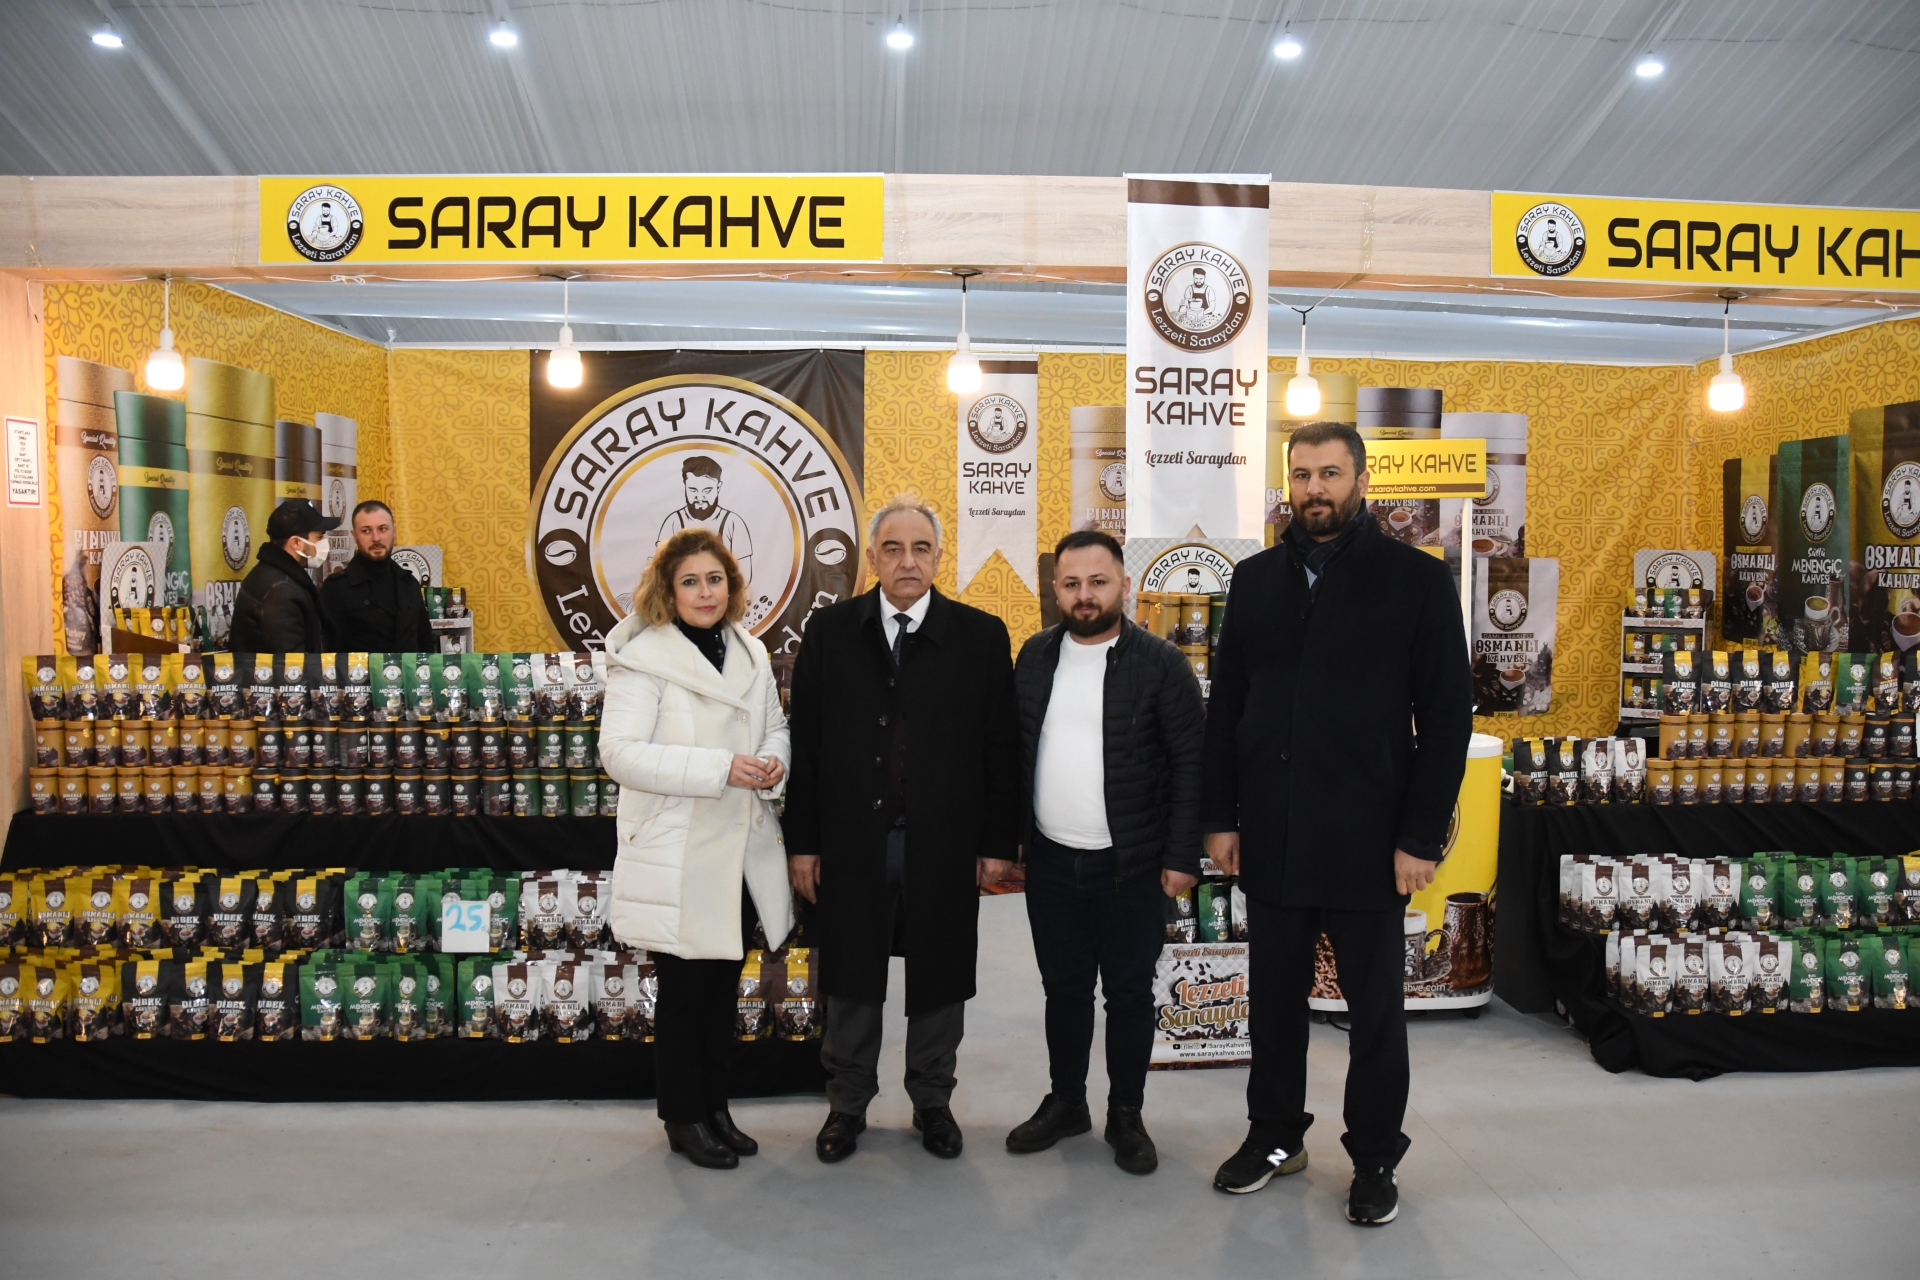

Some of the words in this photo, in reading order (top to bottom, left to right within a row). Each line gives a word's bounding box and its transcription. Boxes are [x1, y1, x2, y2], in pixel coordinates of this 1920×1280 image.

[291, 188, 323, 218] SARAY
[326, 188, 359, 217] KAHVE
[388, 195, 606, 249] SARAY
[629, 195, 845, 248] KAHVE
[1520, 206, 1549, 233] SARAY
[1552, 206, 1581, 234] KAHVE
[291, 233, 318, 260] Lezzeti
[319, 232, 359, 260] Saraydan
[1608, 217, 1799, 274] SARAY
[1818, 226, 1920, 278] KAH
[1151, 248, 1195, 286] SARAY
[1200, 248, 1245, 288] KAHVE
[1520, 247, 1545, 273] Lezzeti
[1546, 250, 1581, 274] Saraydan
[1151, 308, 1187, 345] Lezzeti
[1189, 311, 1244, 347] Saraydan
[1135, 366, 1258, 396] SARAY
[971, 396, 996, 419] SARAY
[998, 397, 1024, 419] KAHVE
[1146, 401, 1246, 426] KAHVE
[971, 430, 993, 451] Lezzeti
[993, 431, 1024, 452] Saraydan
[553, 397, 687, 521] SARAY
[704, 397, 841, 519] KAHVE
[963, 461, 1032, 478] SARAY
[1144, 449, 1184, 467] Lezzeti
[1187, 450, 1247, 469] Saraydan
[1366, 454, 1405, 474] RAY
[1411, 453, 1477, 473] KAHVE
[969, 480, 1025, 495] KAHVE
[1368, 485, 1437, 493] w.saraykahve.com
[1885, 466, 1907, 496] SARAY
[968, 507, 991, 516] Lezzeti
[991, 507, 1026, 518] Saraydan
[1454, 514, 1509, 527] OMANLI
[1884, 510, 1901, 537] Lezzeti
[114, 555, 134, 583] SARAY
[135, 551, 153, 580] KAHVE
[405, 552, 428, 573] KAHVE
[1148, 550, 1190, 588] SARAY
[1650, 556, 1673, 576] SARAY
[1675, 557, 1700, 577] KAHVE
[1730, 554, 1776, 571] OSMANLI
[1791, 558, 1843, 579] MENENGİÇ
[1801, 573, 1830, 585] KAHVESİ
[1877, 573, 1920, 589] KAHVE
[1475, 639, 1540, 654] OSMANLI
[213, 913, 243, 922] DİBEK
[1172, 949, 1201, 958] Lezzeti
[1202, 948, 1246, 958] Saraydan
[1174, 974, 1247, 1005] Lezzeti
[216, 999, 246, 1010] DİBEK
[1158, 999, 1250, 1031] Sarayda
